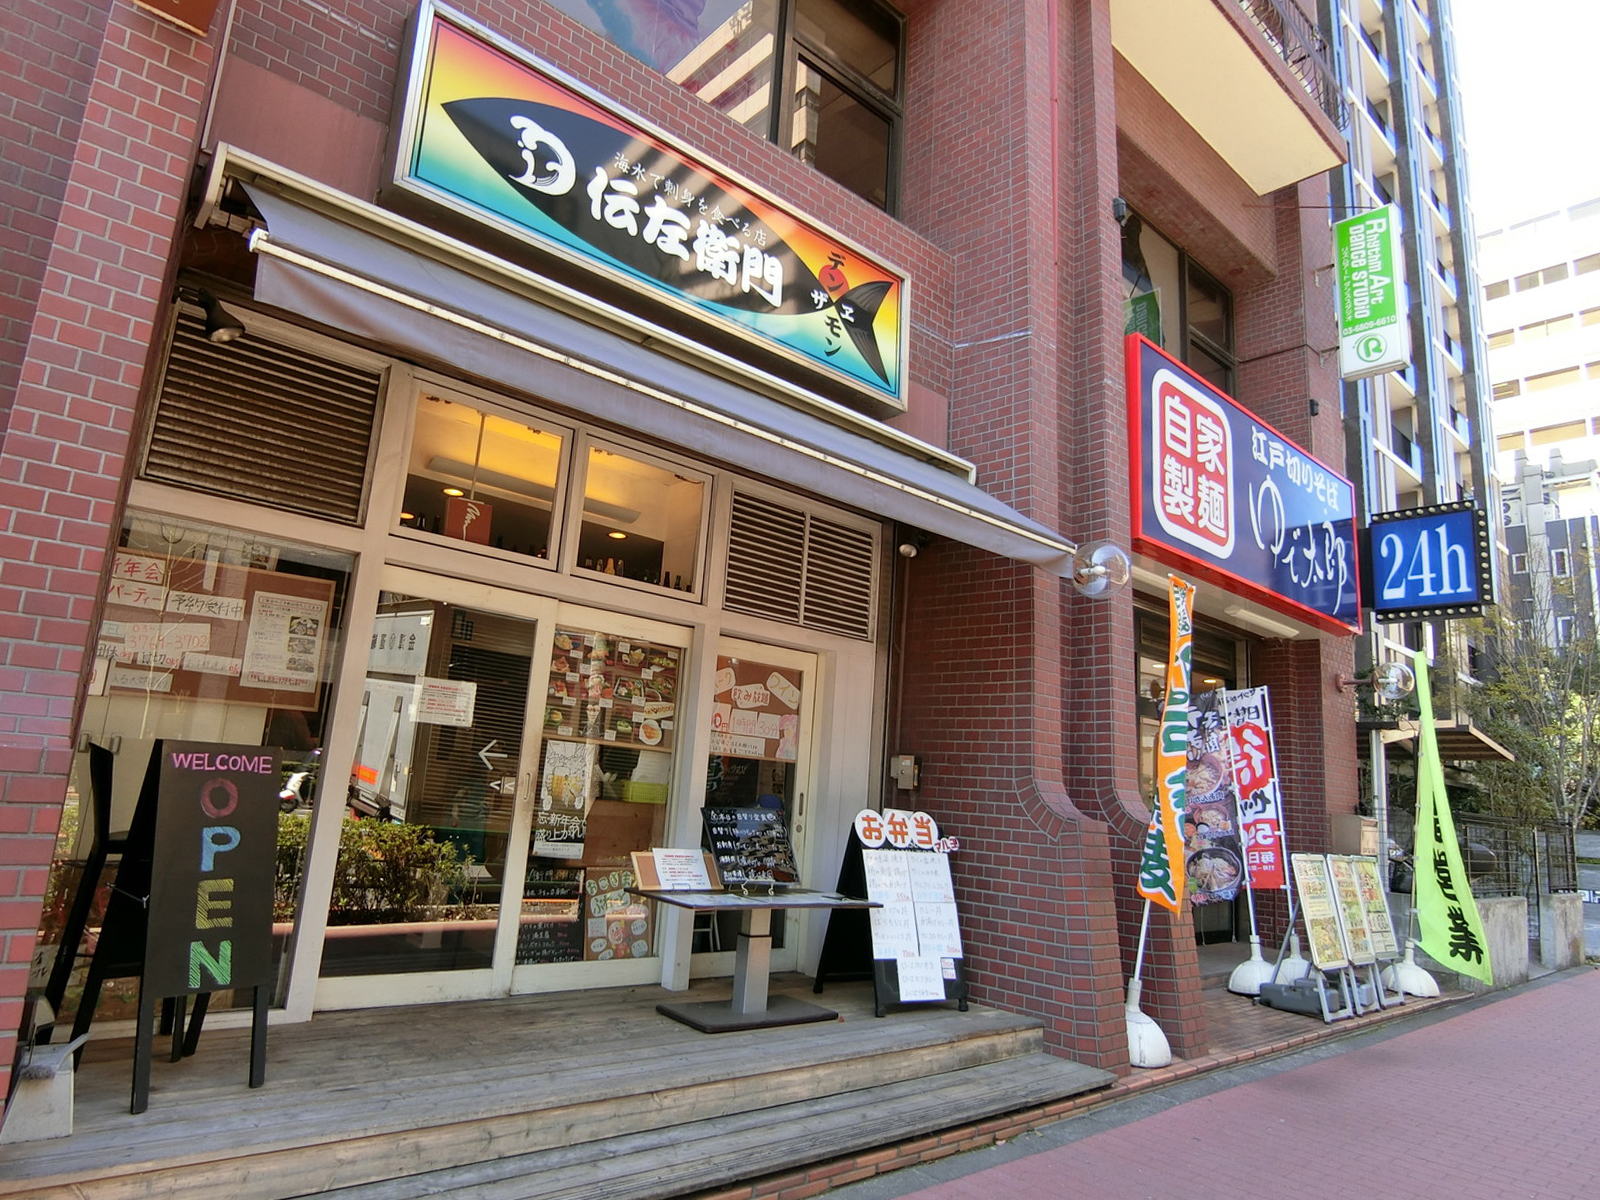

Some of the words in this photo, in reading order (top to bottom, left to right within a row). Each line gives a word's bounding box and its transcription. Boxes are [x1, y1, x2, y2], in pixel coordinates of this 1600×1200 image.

[613, 152, 767, 247] 海水で刺身を食べる店
[586, 165, 783, 308] 伝左衛門
[1366, 217, 1387, 274] Rhythm
[1369, 275, 1392, 306] Art
[1342, 314, 1397, 336] 03-6809-6610
[1251, 425, 1339, 512] 江戸切りそば
[1248, 474, 1347, 615] ゆで太郎
[1380, 522, 1473, 600] 24h
[108, 584, 165, 604] パーティー
[171, 594, 243, 618] 予約受付中
[733, 687, 769, 705] 飲み放題
[172, 752, 273, 775] WELCOME
[861, 812, 933, 845] お弁当
[188, 777, 242, 989] OPEN
